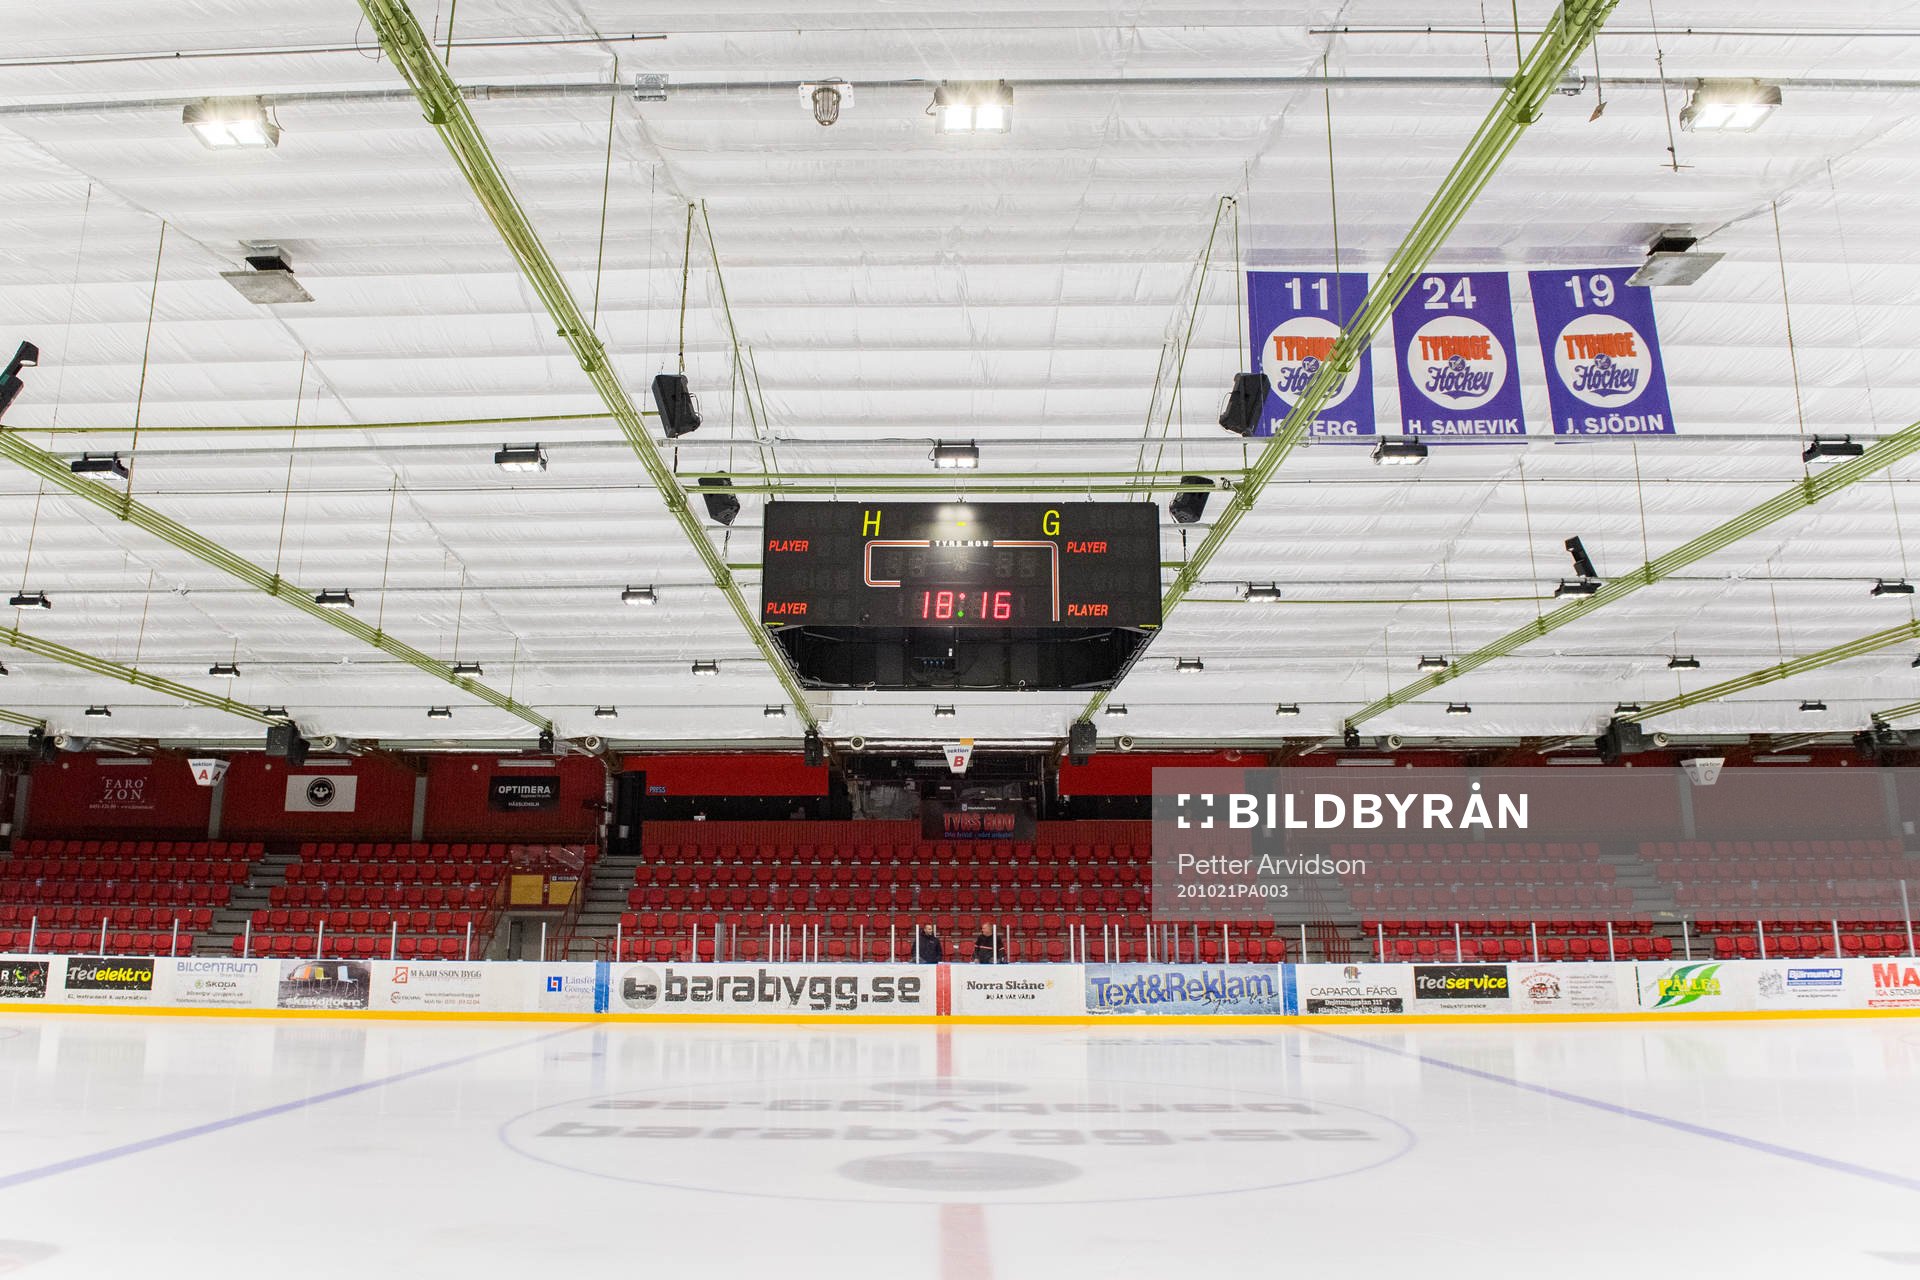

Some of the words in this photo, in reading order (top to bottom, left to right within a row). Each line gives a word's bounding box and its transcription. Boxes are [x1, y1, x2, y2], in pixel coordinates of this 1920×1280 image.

[1285, 278, 1328, 310] 11
[1423, 277, 1476, 310] 24
[1565, 274, 1615, 307] 19
[1425, 366, 1493, 399] Hockey
[1573, 364, 1639, 397] Hockey
[1408, 419, 1426, 434] H.
[1431, 418, 1519, 434] SAMEVIK
[1565, 417, 1580, 434] J.
[1584, 413, 1664, 433] SJÖDIN
[862, 510, 881, 536] H
[1042, 510, 1060, 535] G
[769, 540, 809, 552] PLAYER
[1067, 541, 1107, 553] PLAYER
[766, 602, 807, 614] PLAYER
[922, 591, 1012, 619] 18:16
[1068, 604, 1109, 616] PLAYER
[954, 756, 964, 767] B
[199, 769, 208, 780] A
[106, 779, 144, 788] FARO
[498, 785, 551, 794] OPTIMERA
[104, 789, 142, 800] ZON
[67, 966, 152, 981] Tedelektro
[665, 968, 920, 1010] barabygg.se
[967, 981, 1004, 990] Norra
[1005, 979, 1045, 990] Skåne
[1091, 969, 1273, 1006] Text&Reklam
[1417, 974, 1508, 990] Tedservice
[1310, 987, 1364, 996] CAPAROL
[538, 1121, 1382, 1147] barabygg.se
